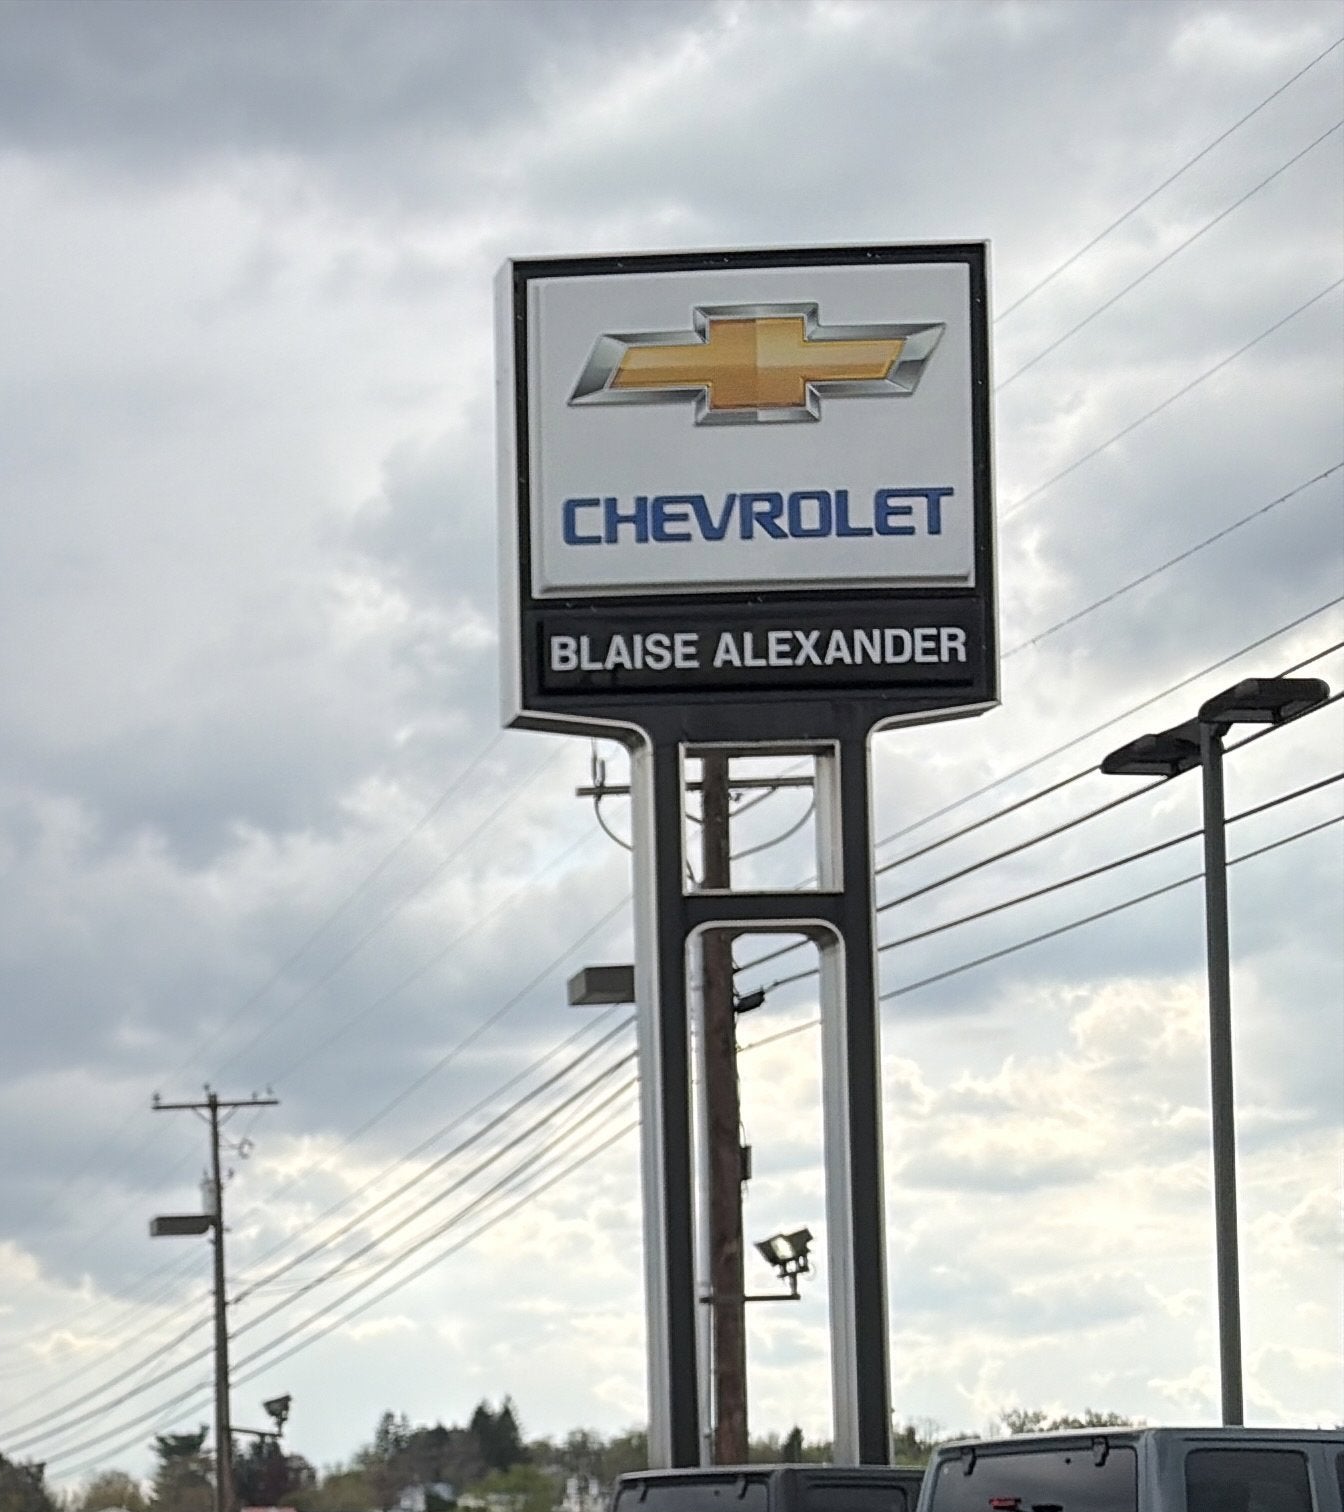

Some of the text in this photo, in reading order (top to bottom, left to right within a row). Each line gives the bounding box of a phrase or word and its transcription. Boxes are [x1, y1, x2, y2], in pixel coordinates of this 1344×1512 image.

[562, 486, 955, 546] CHEVROLET
[550, 626, 968, 672] BLAISE ALEXANDER
